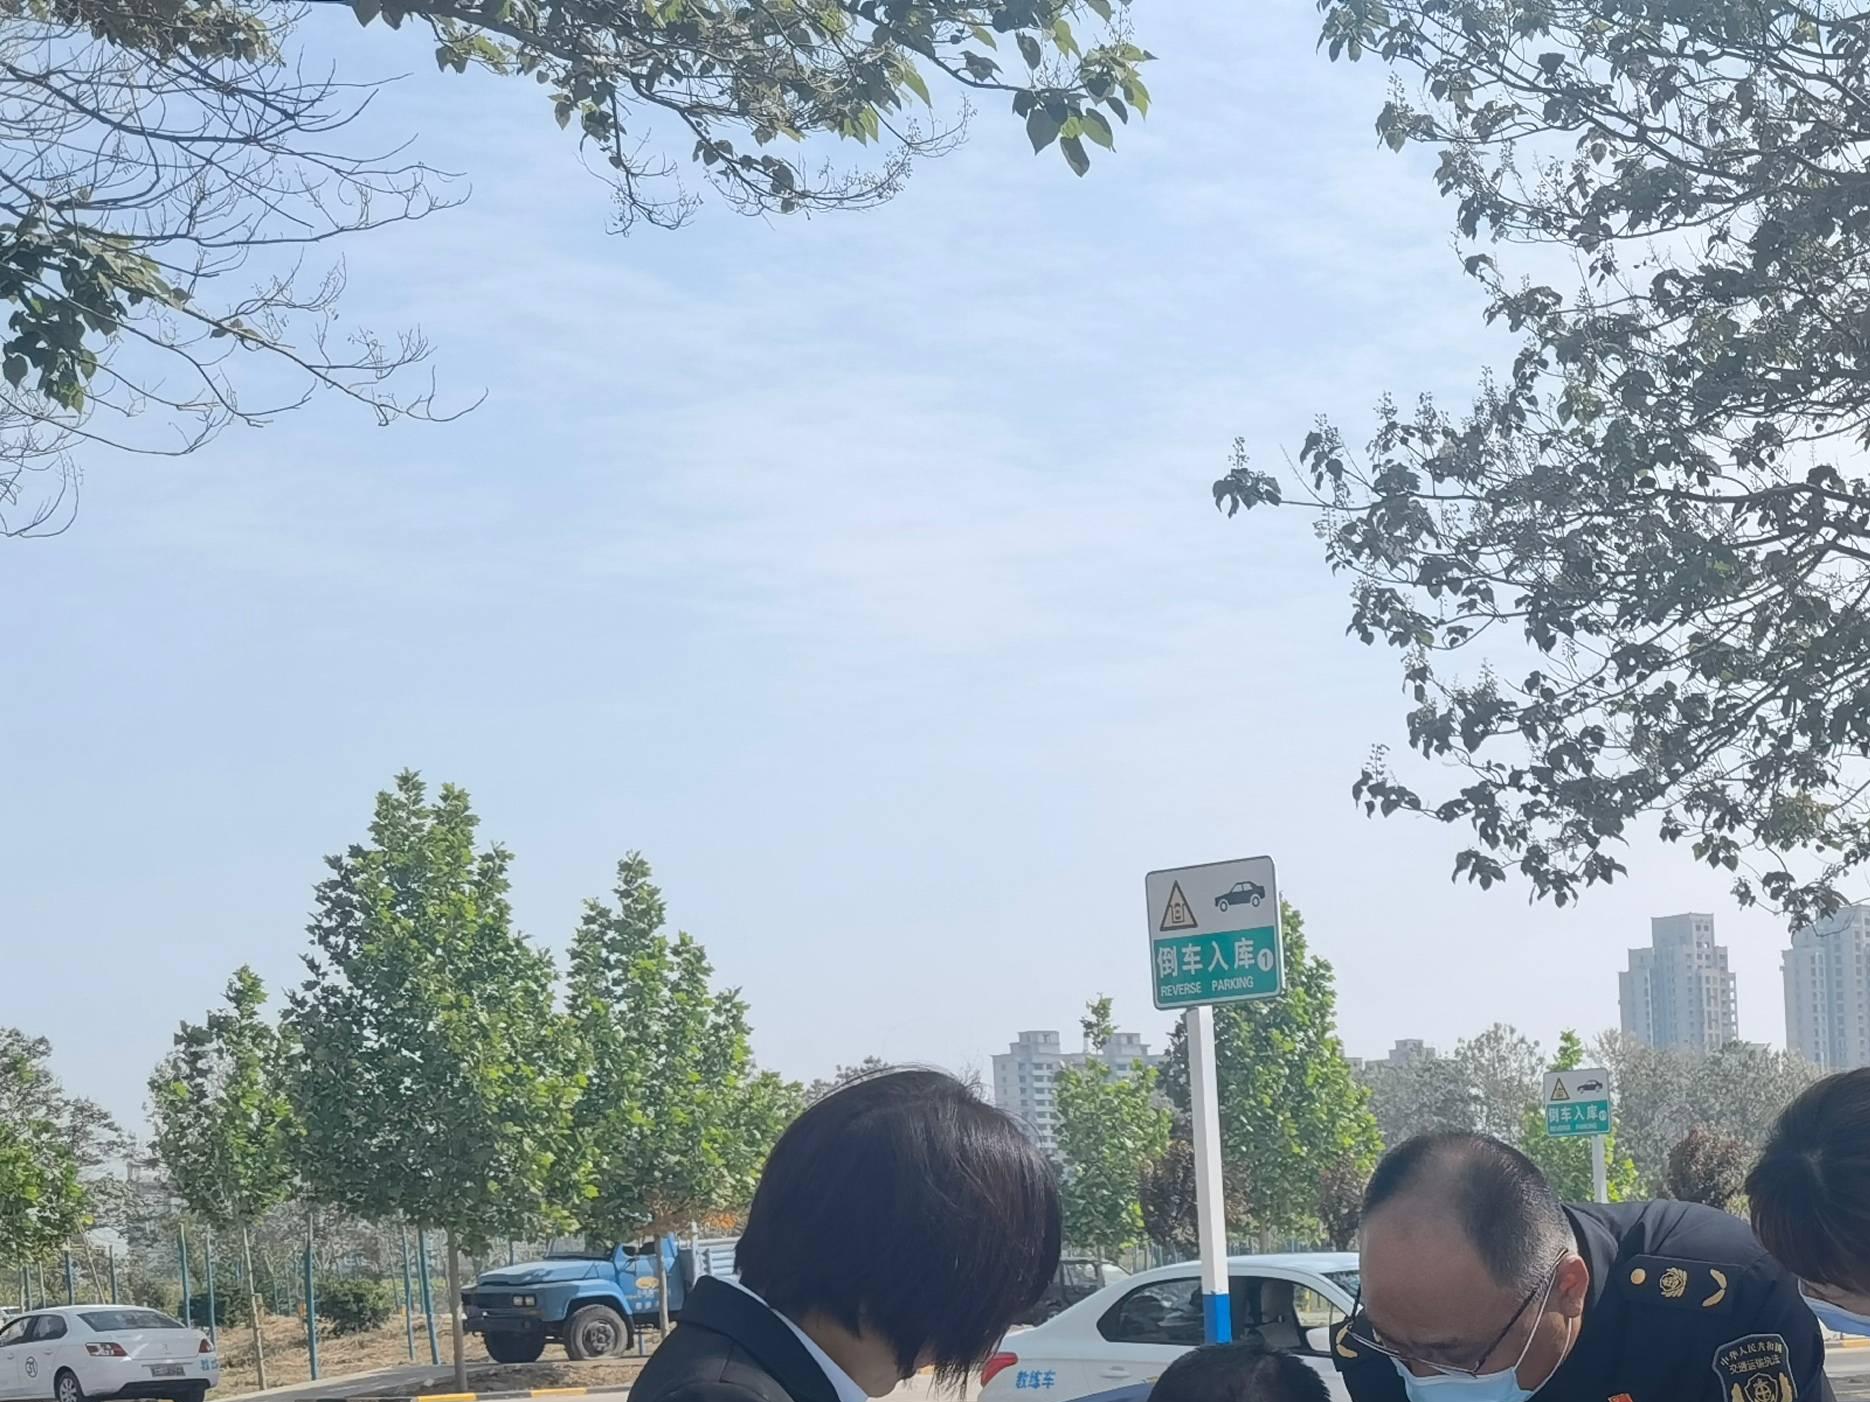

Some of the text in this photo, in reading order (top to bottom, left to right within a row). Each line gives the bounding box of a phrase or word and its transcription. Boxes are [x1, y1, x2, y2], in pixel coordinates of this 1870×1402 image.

[1160, 975, 1255, 998] REVERSE PARKING
[1015, 1369, 1057, 1390] 教练车
